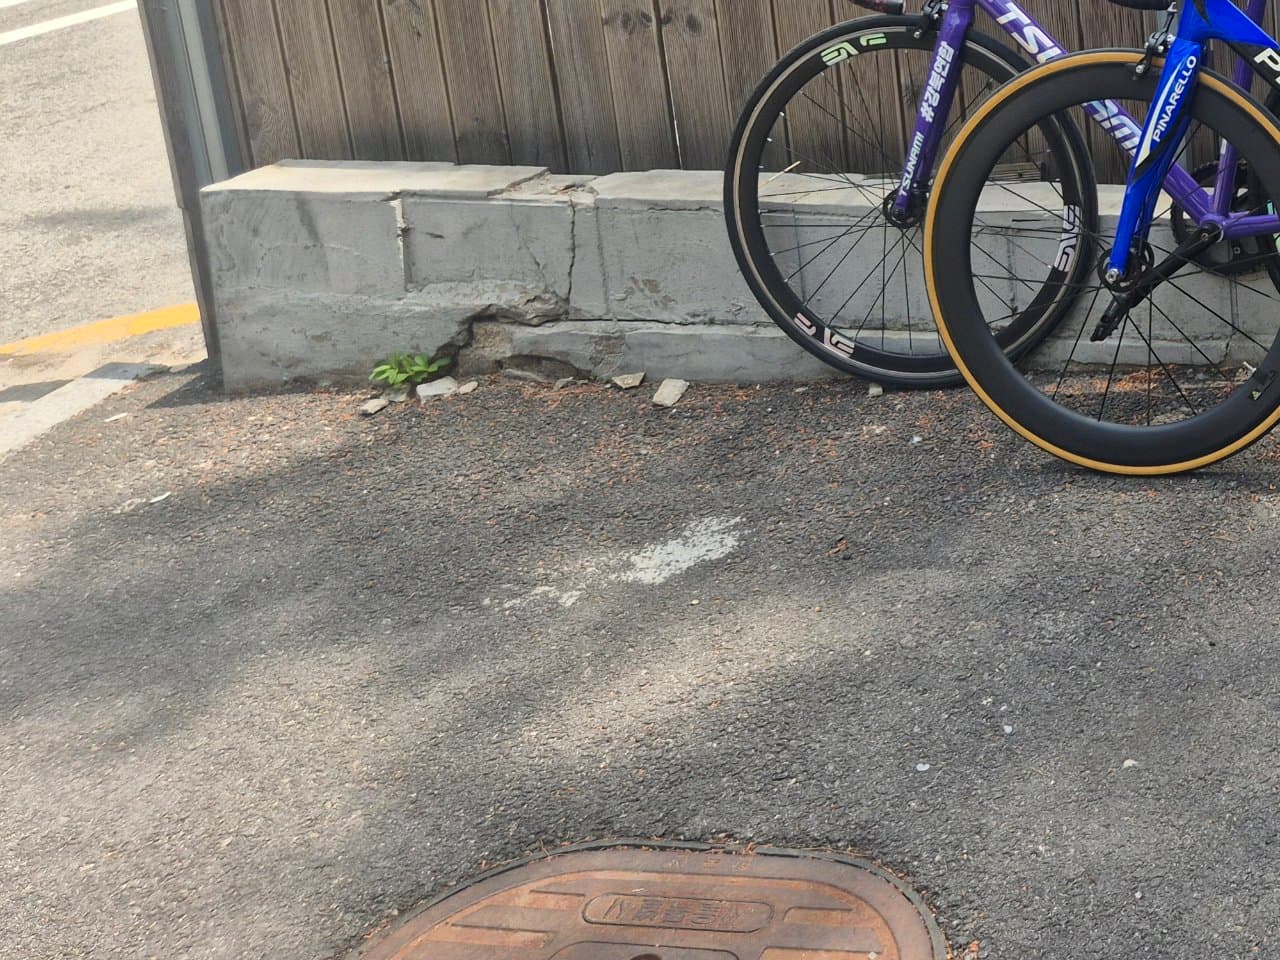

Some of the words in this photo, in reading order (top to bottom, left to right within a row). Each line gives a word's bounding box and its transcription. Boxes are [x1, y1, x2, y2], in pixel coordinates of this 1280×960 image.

[920, 40, 955, 123] #강북연합
[1152, 55, 1197, 143] PINARELLO
[899, 131, 925, 196] TSUNAMI
